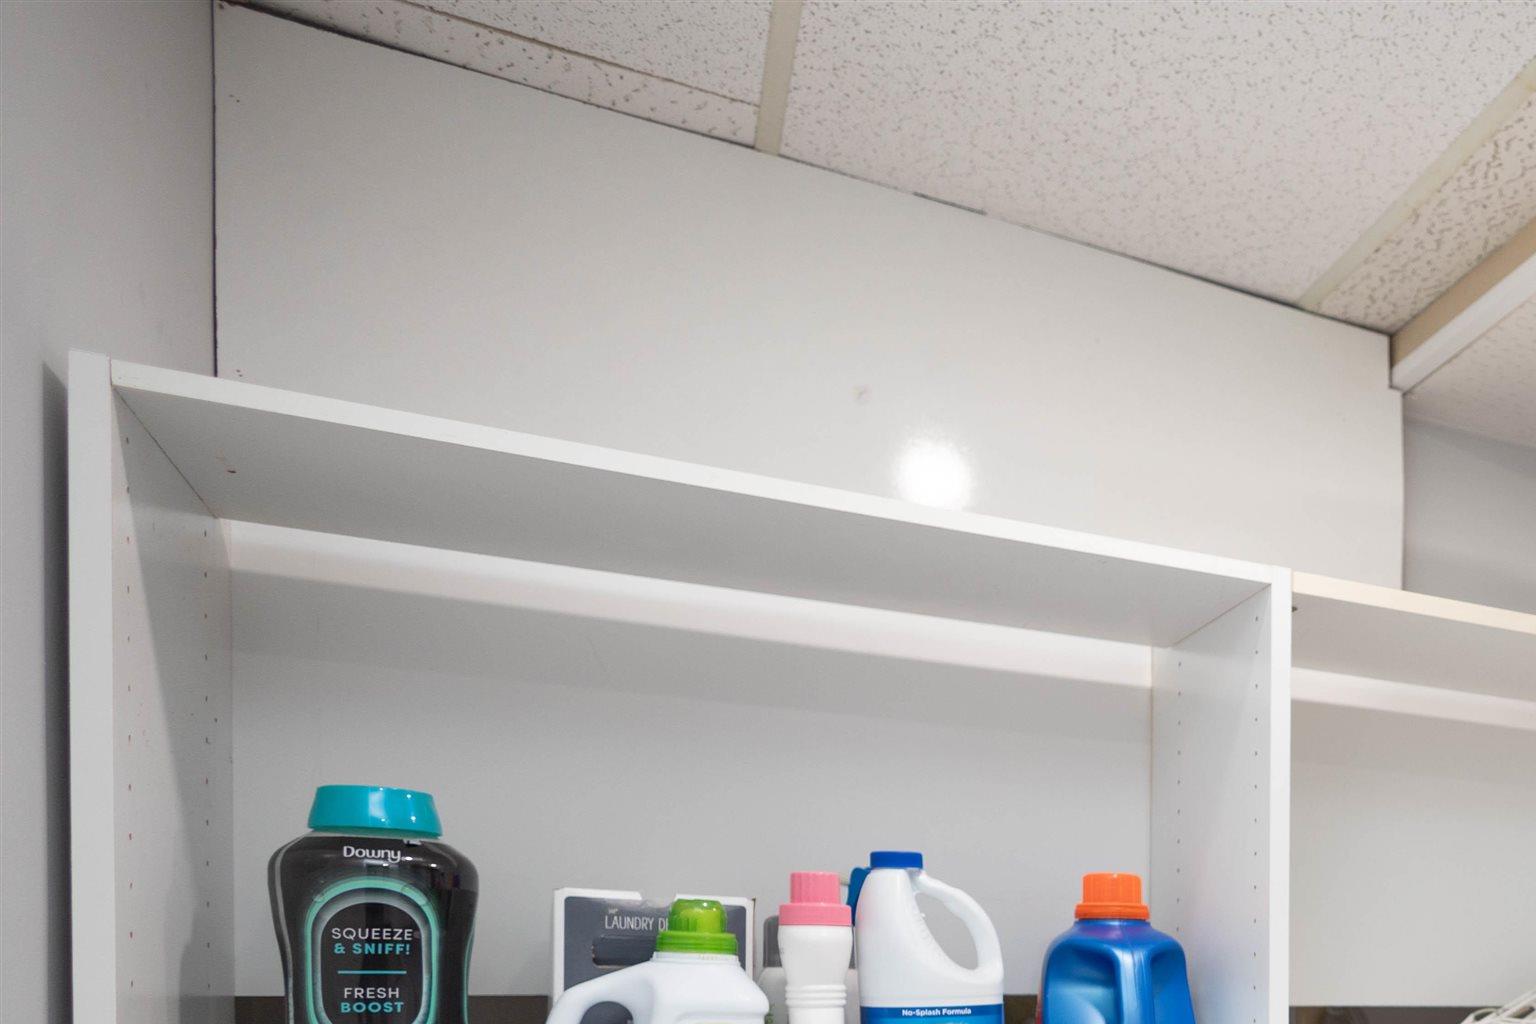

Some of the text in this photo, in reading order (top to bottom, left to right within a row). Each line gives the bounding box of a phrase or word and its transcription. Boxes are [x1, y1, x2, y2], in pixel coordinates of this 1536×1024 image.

[343, 846, 401, 863] Downy
[605, 915, 654, 931] LAUNDRY
[332, 927, 413, 941] SQUEEZE
[334, 943, 410, 955] & SNIFF!
[344, 987, 400, 999] FRESH
[341, 1002, 404, 1013] BOOST
[902, 1008, 972, 1017] No-Splash Formula
